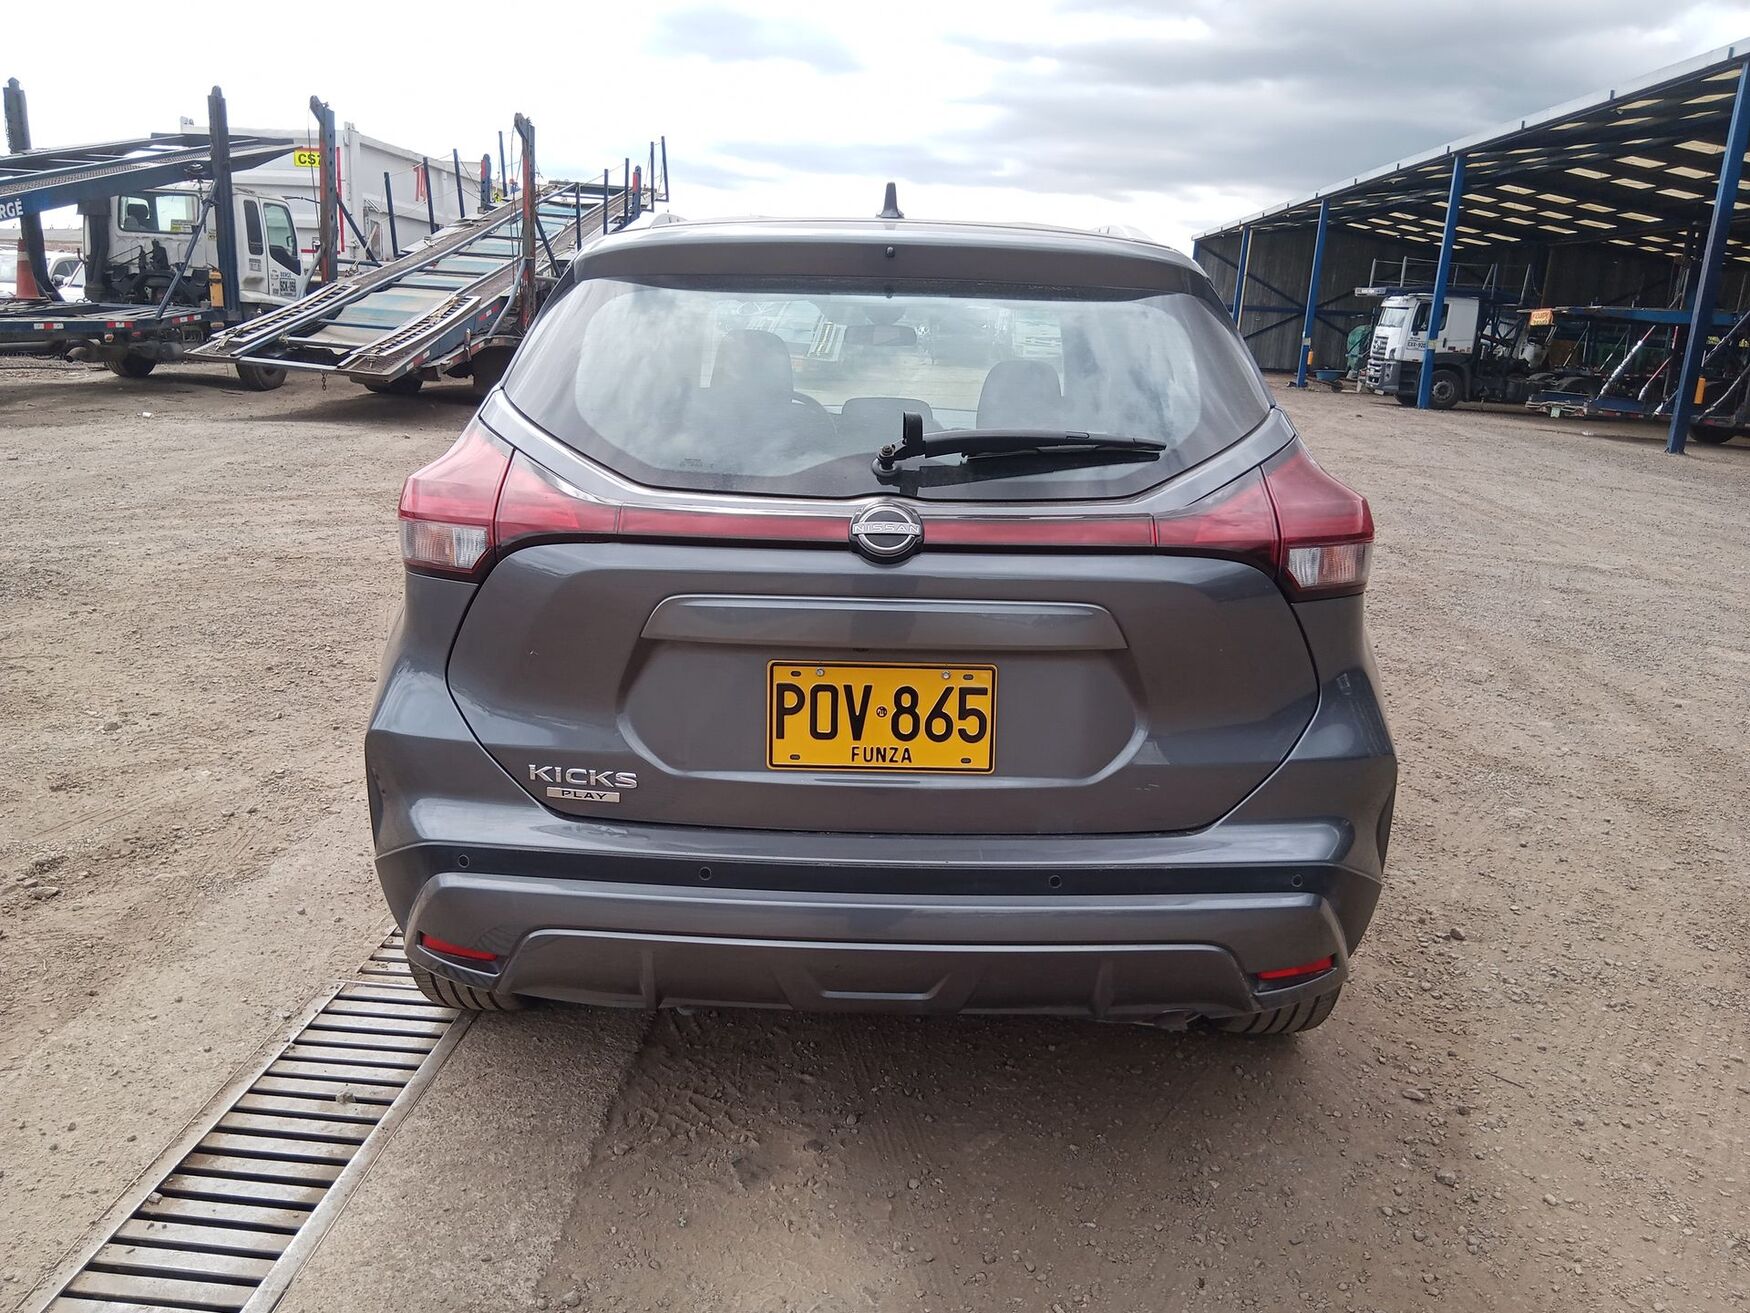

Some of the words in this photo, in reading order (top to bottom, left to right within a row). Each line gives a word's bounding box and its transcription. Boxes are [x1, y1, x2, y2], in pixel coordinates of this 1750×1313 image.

[854, 523, 919, 535] NISSAN
[851, 747, 912, 763] FUNZA
[528, 764, 637, 789] KICKS
[561, 789, 607, 800] PLAY
